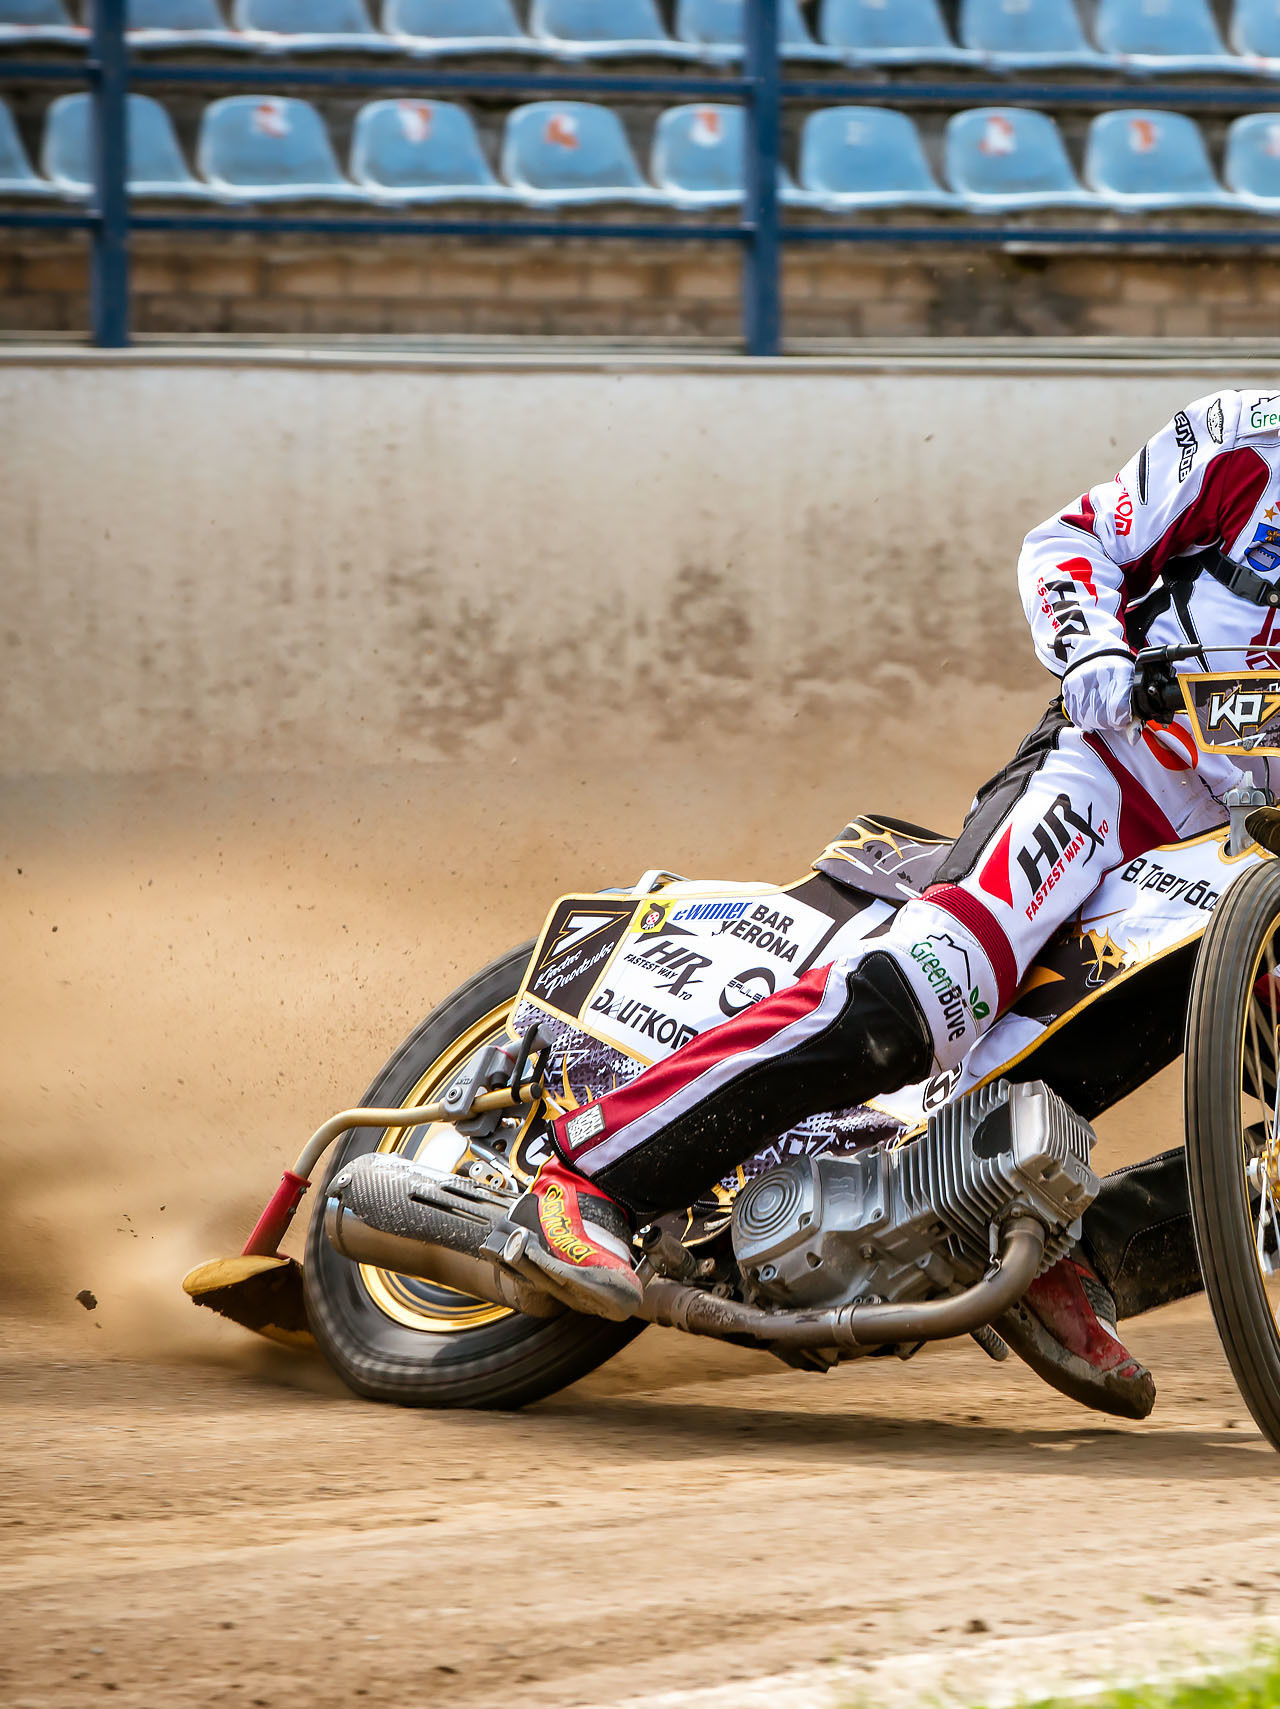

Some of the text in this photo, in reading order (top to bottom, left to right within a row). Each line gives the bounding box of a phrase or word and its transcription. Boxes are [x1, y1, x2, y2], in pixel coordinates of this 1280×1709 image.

[1025, 818, 1109, 922] FASTEST WAY TO
[750, 904, 795, 935] BAR
[623, 953, 693, 1001] FASTEST WAY TO
